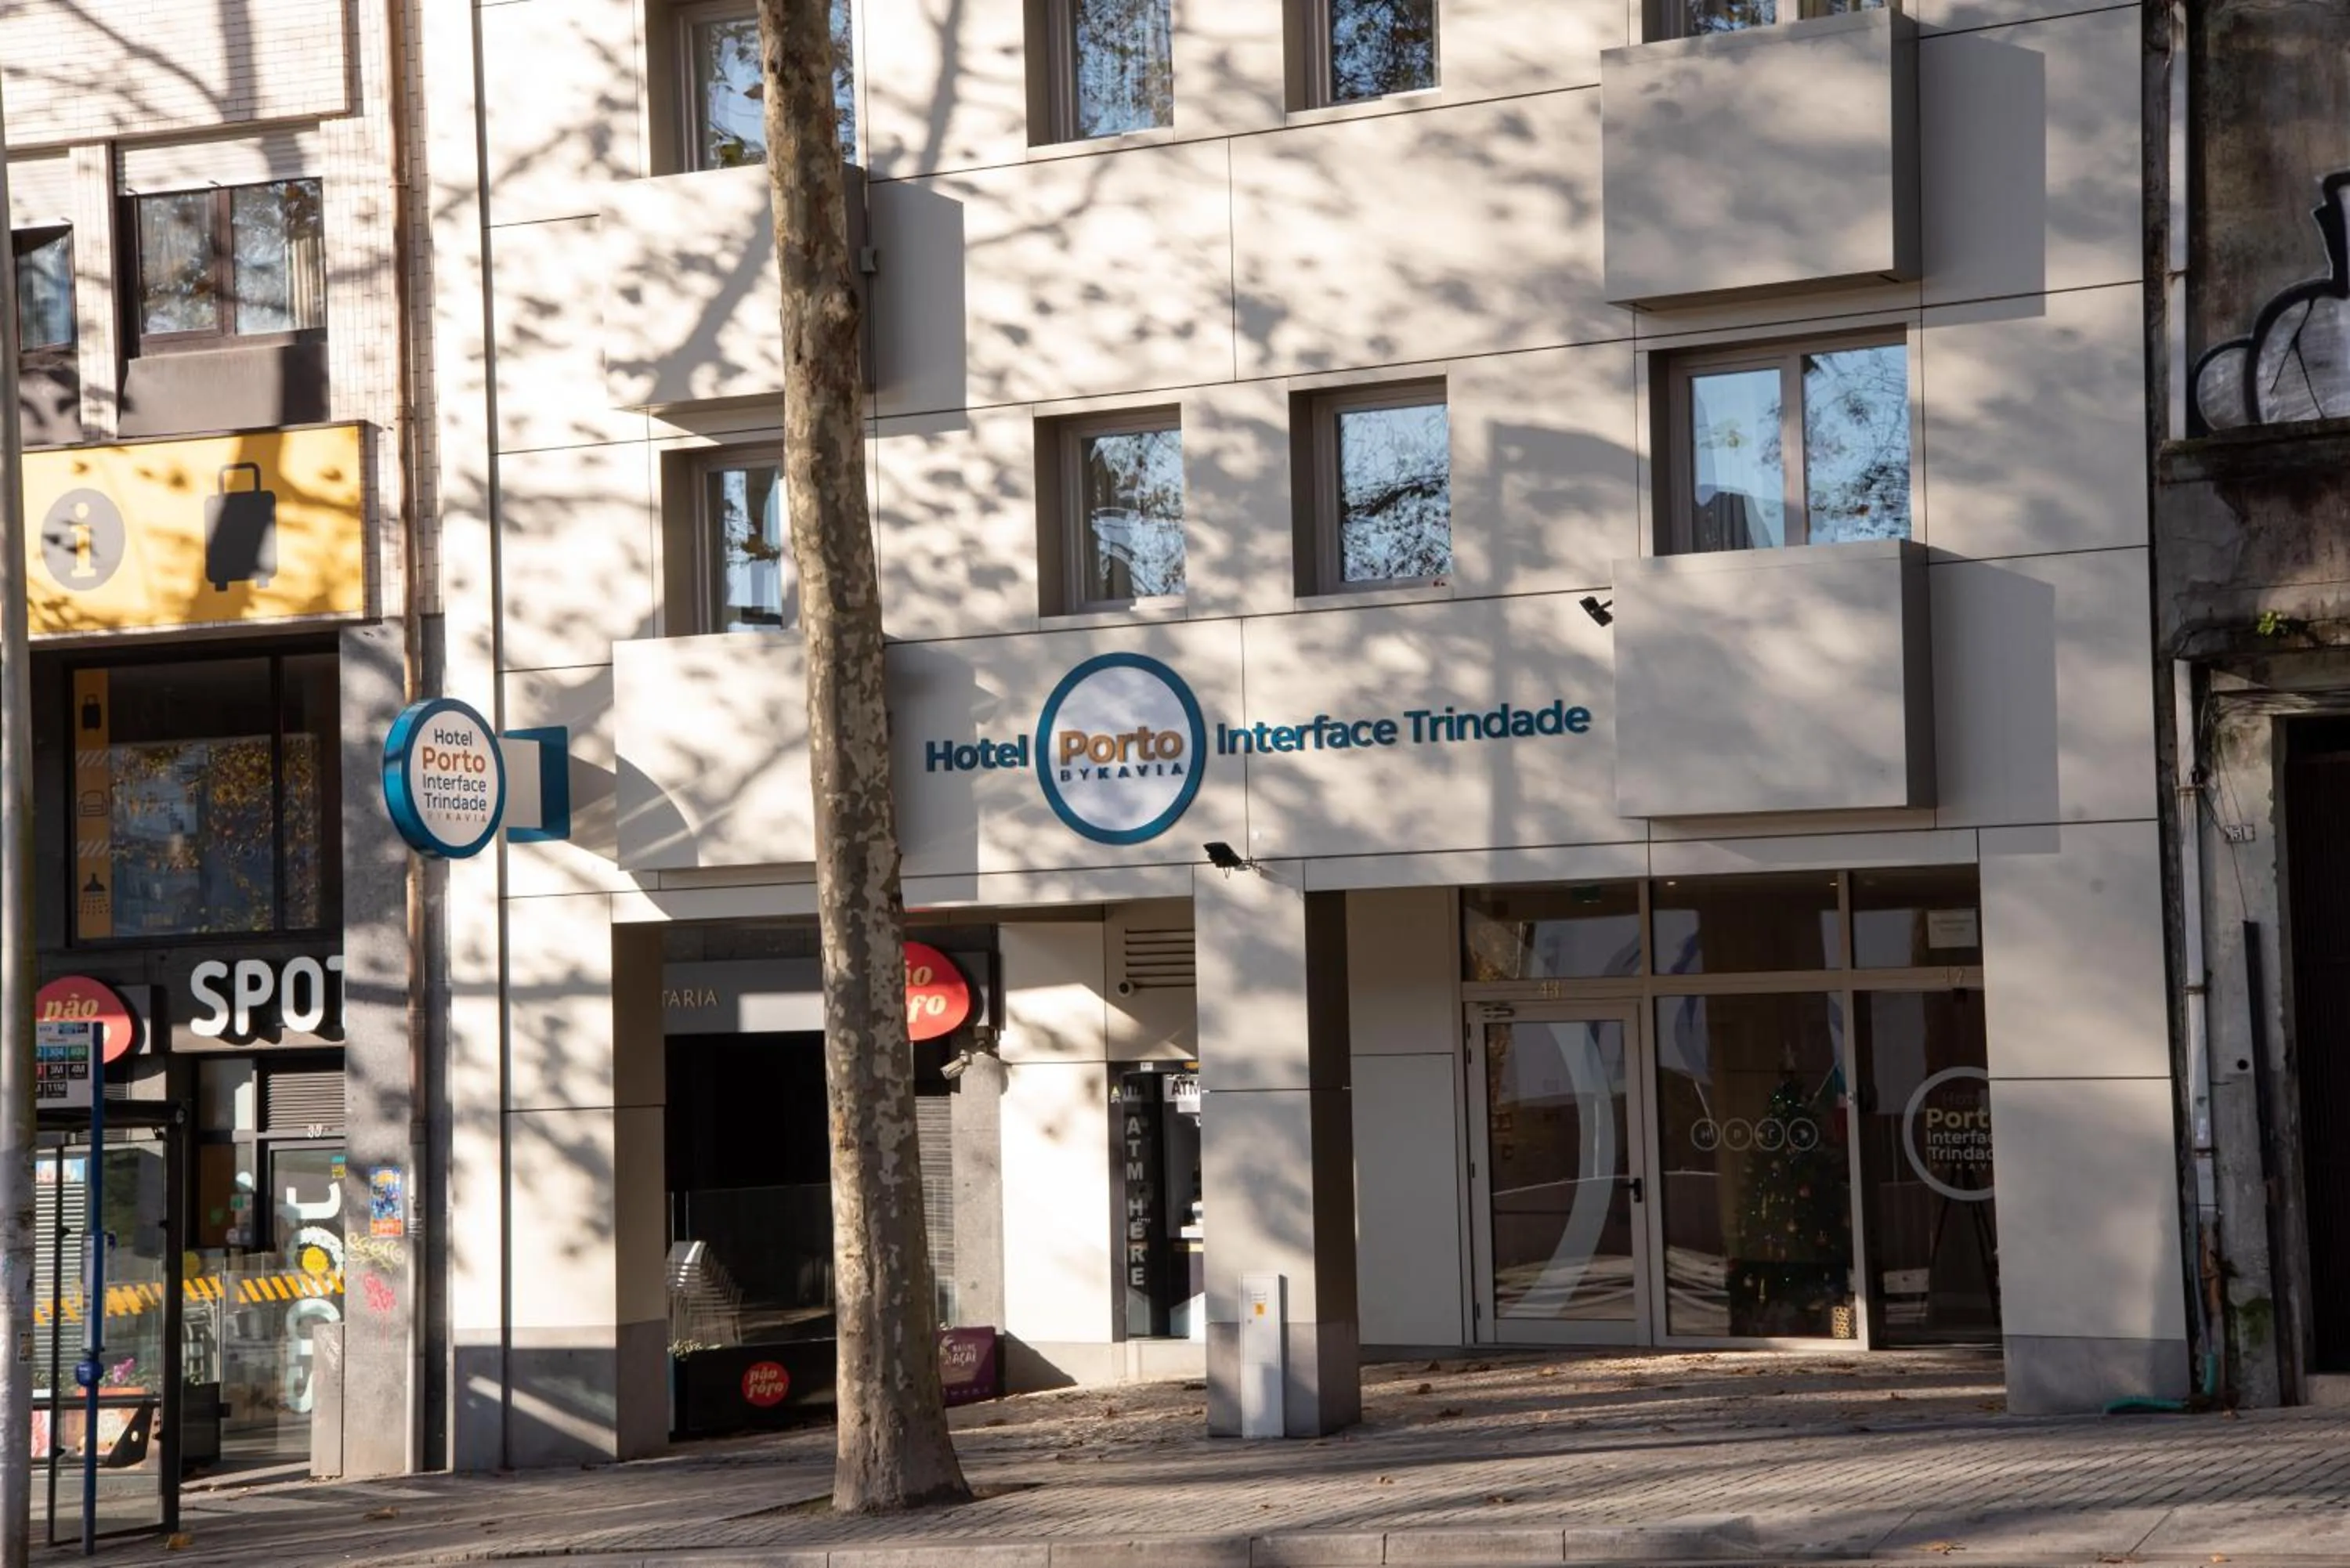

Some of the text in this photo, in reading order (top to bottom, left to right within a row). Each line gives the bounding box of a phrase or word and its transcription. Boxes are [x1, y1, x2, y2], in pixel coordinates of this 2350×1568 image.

[434, 728, 472, 746] Hotel
[925, 699, 1592, 771] Hotel Porto Interface Trindade
[421, 746, 486, 773] Porto
[422, 773, 487, 793] Interface
[424, 793, 487, 811] Trindade
[43, 992, 99, 1021] pão
[907, 993, 947, 1024] fo
[1926, 1107, 1990, 1129] Port
